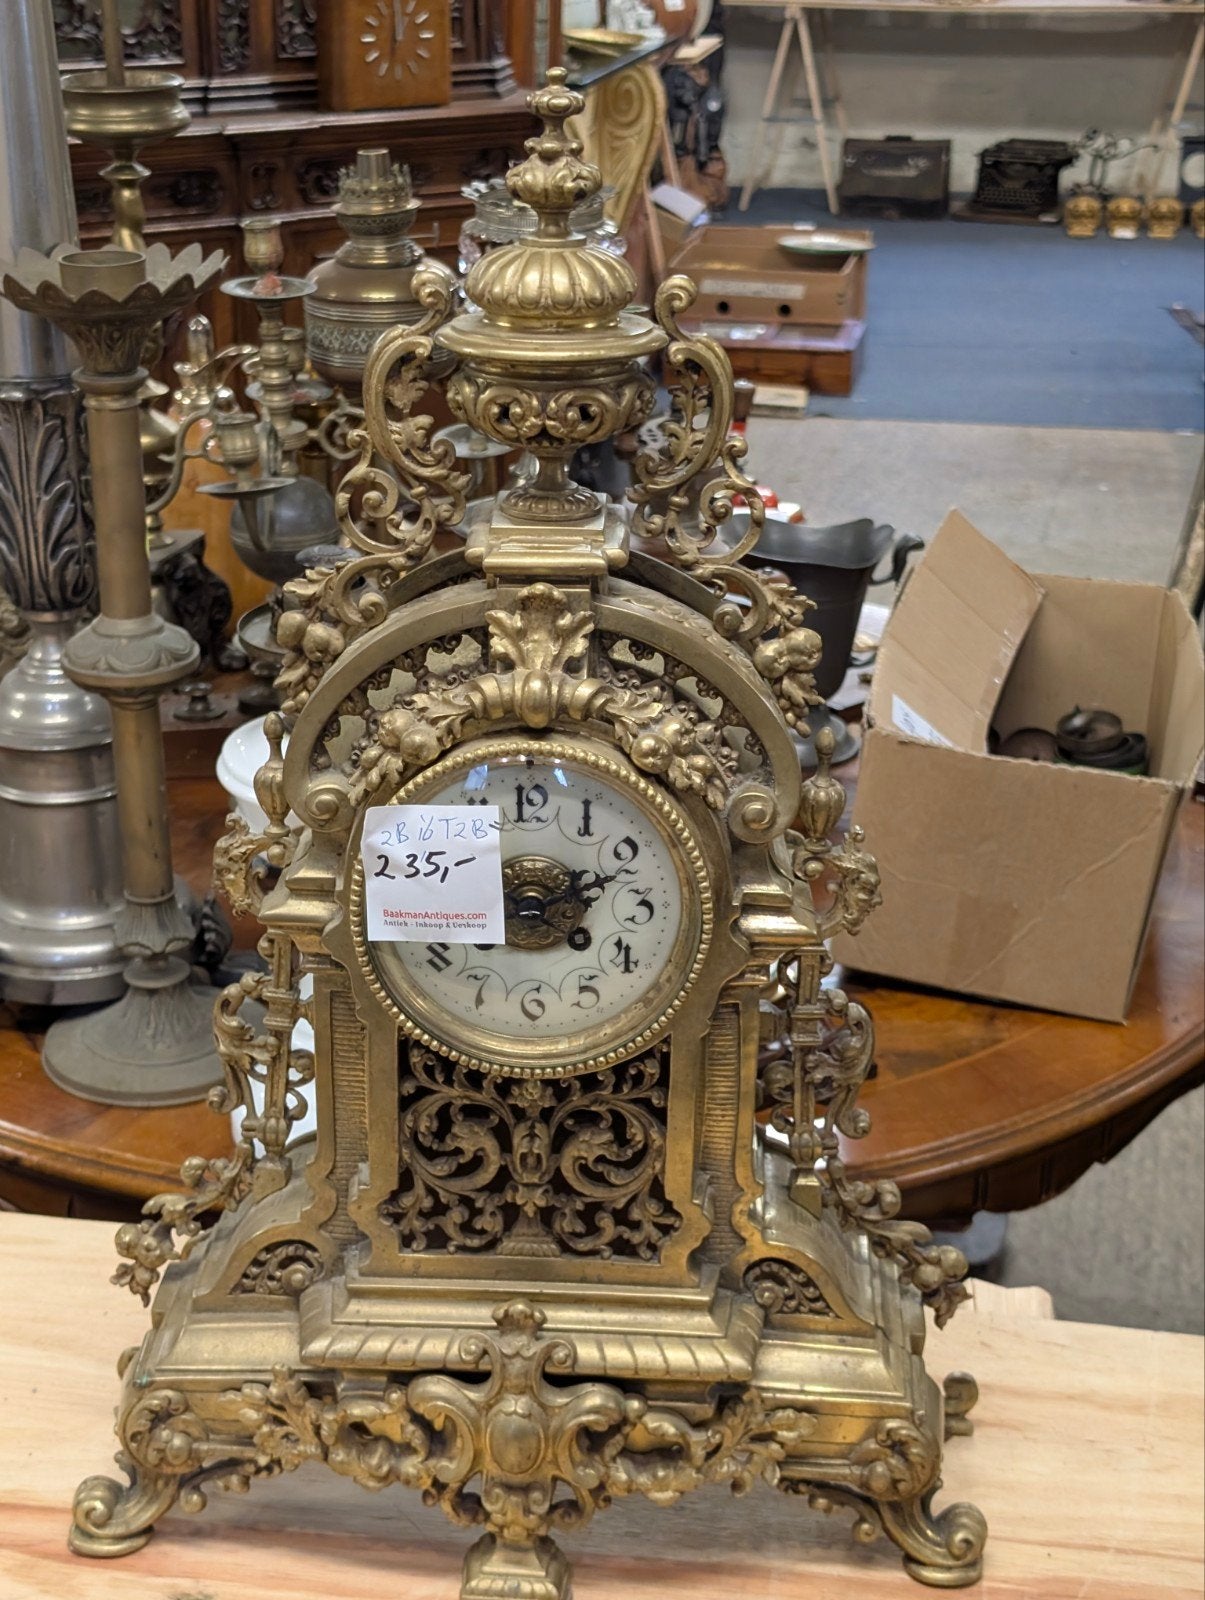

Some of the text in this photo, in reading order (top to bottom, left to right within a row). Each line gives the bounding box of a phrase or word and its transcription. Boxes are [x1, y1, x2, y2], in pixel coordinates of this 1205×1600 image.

[514, 783, 549, 823] 12
[577, 798, 595, 838] 1
[613, 836, 639, 875] 2
[383, 909, 487, 921] BaakmanAntiques.com
[384, 919, 408, 927] Antiek
[416, 921, 444, 930] Inkoop
[627, 888, 655, 926] 3
[609, 936, 639, 974] 4
[466, 973, 492, 1011] 7
[520, 984, 546, 1022] 6
[570, 974, 600, 1009] 5
